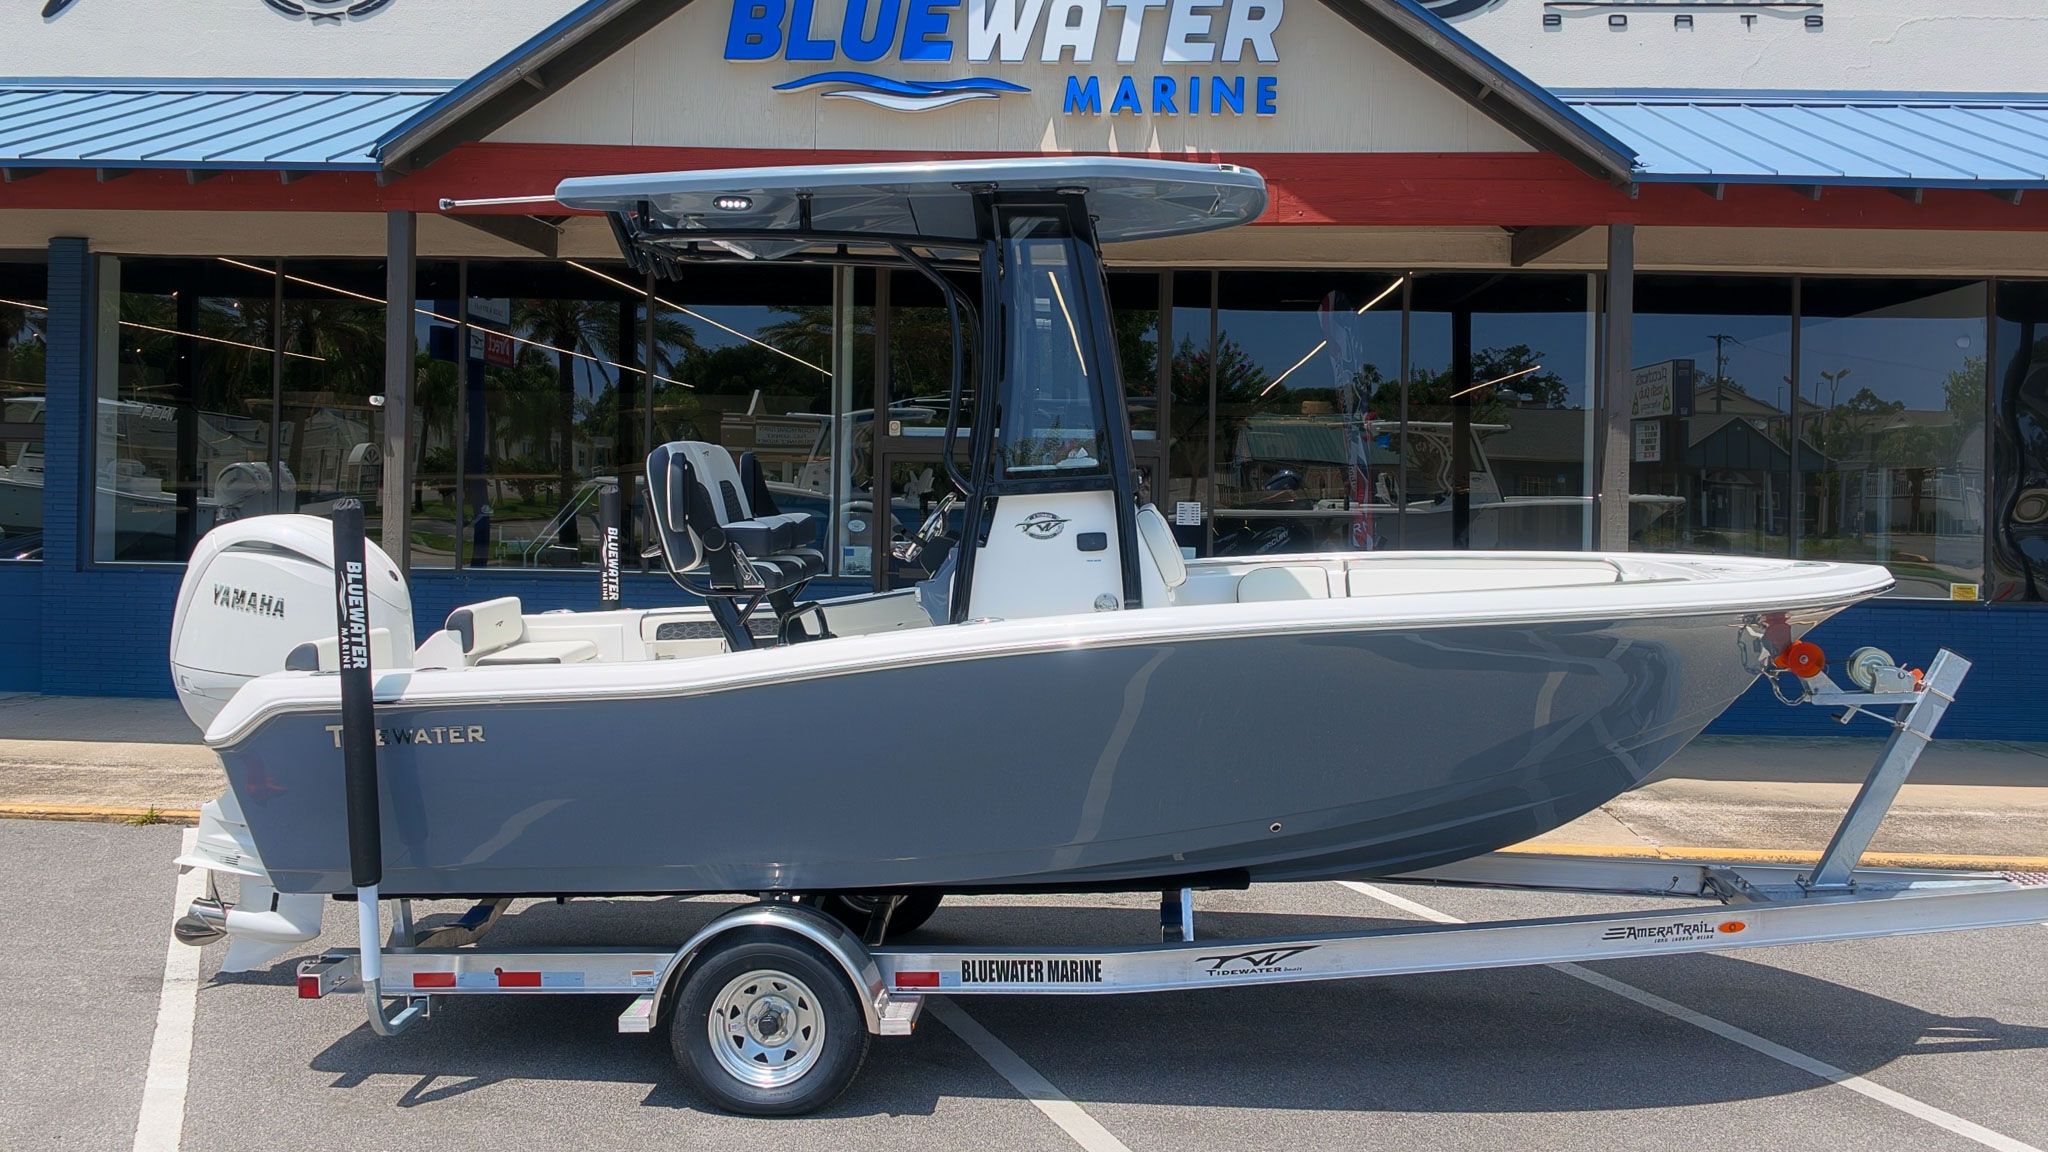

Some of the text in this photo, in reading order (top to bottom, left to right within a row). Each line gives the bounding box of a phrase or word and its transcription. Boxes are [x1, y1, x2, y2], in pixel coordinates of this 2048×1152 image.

[723, 0, 1284, 62] BLUEWATER
[1543, 14, 1824, 29] BOATS
[1063, 75, 1278, 116] MARINE
[607, 526, 619, 601] BLUEWATER
[214, 583, 286, 619] YAMAHA
[346, 561, 368, 670] BLUEWATER
[340, 627, 352, 669] MARINE
[325, 725, 487, 748] TEWATER
[961, 959, 1103, 983] BLUEWATER MARINE
[1205, 966, 1282, 977] TIDEWATER
